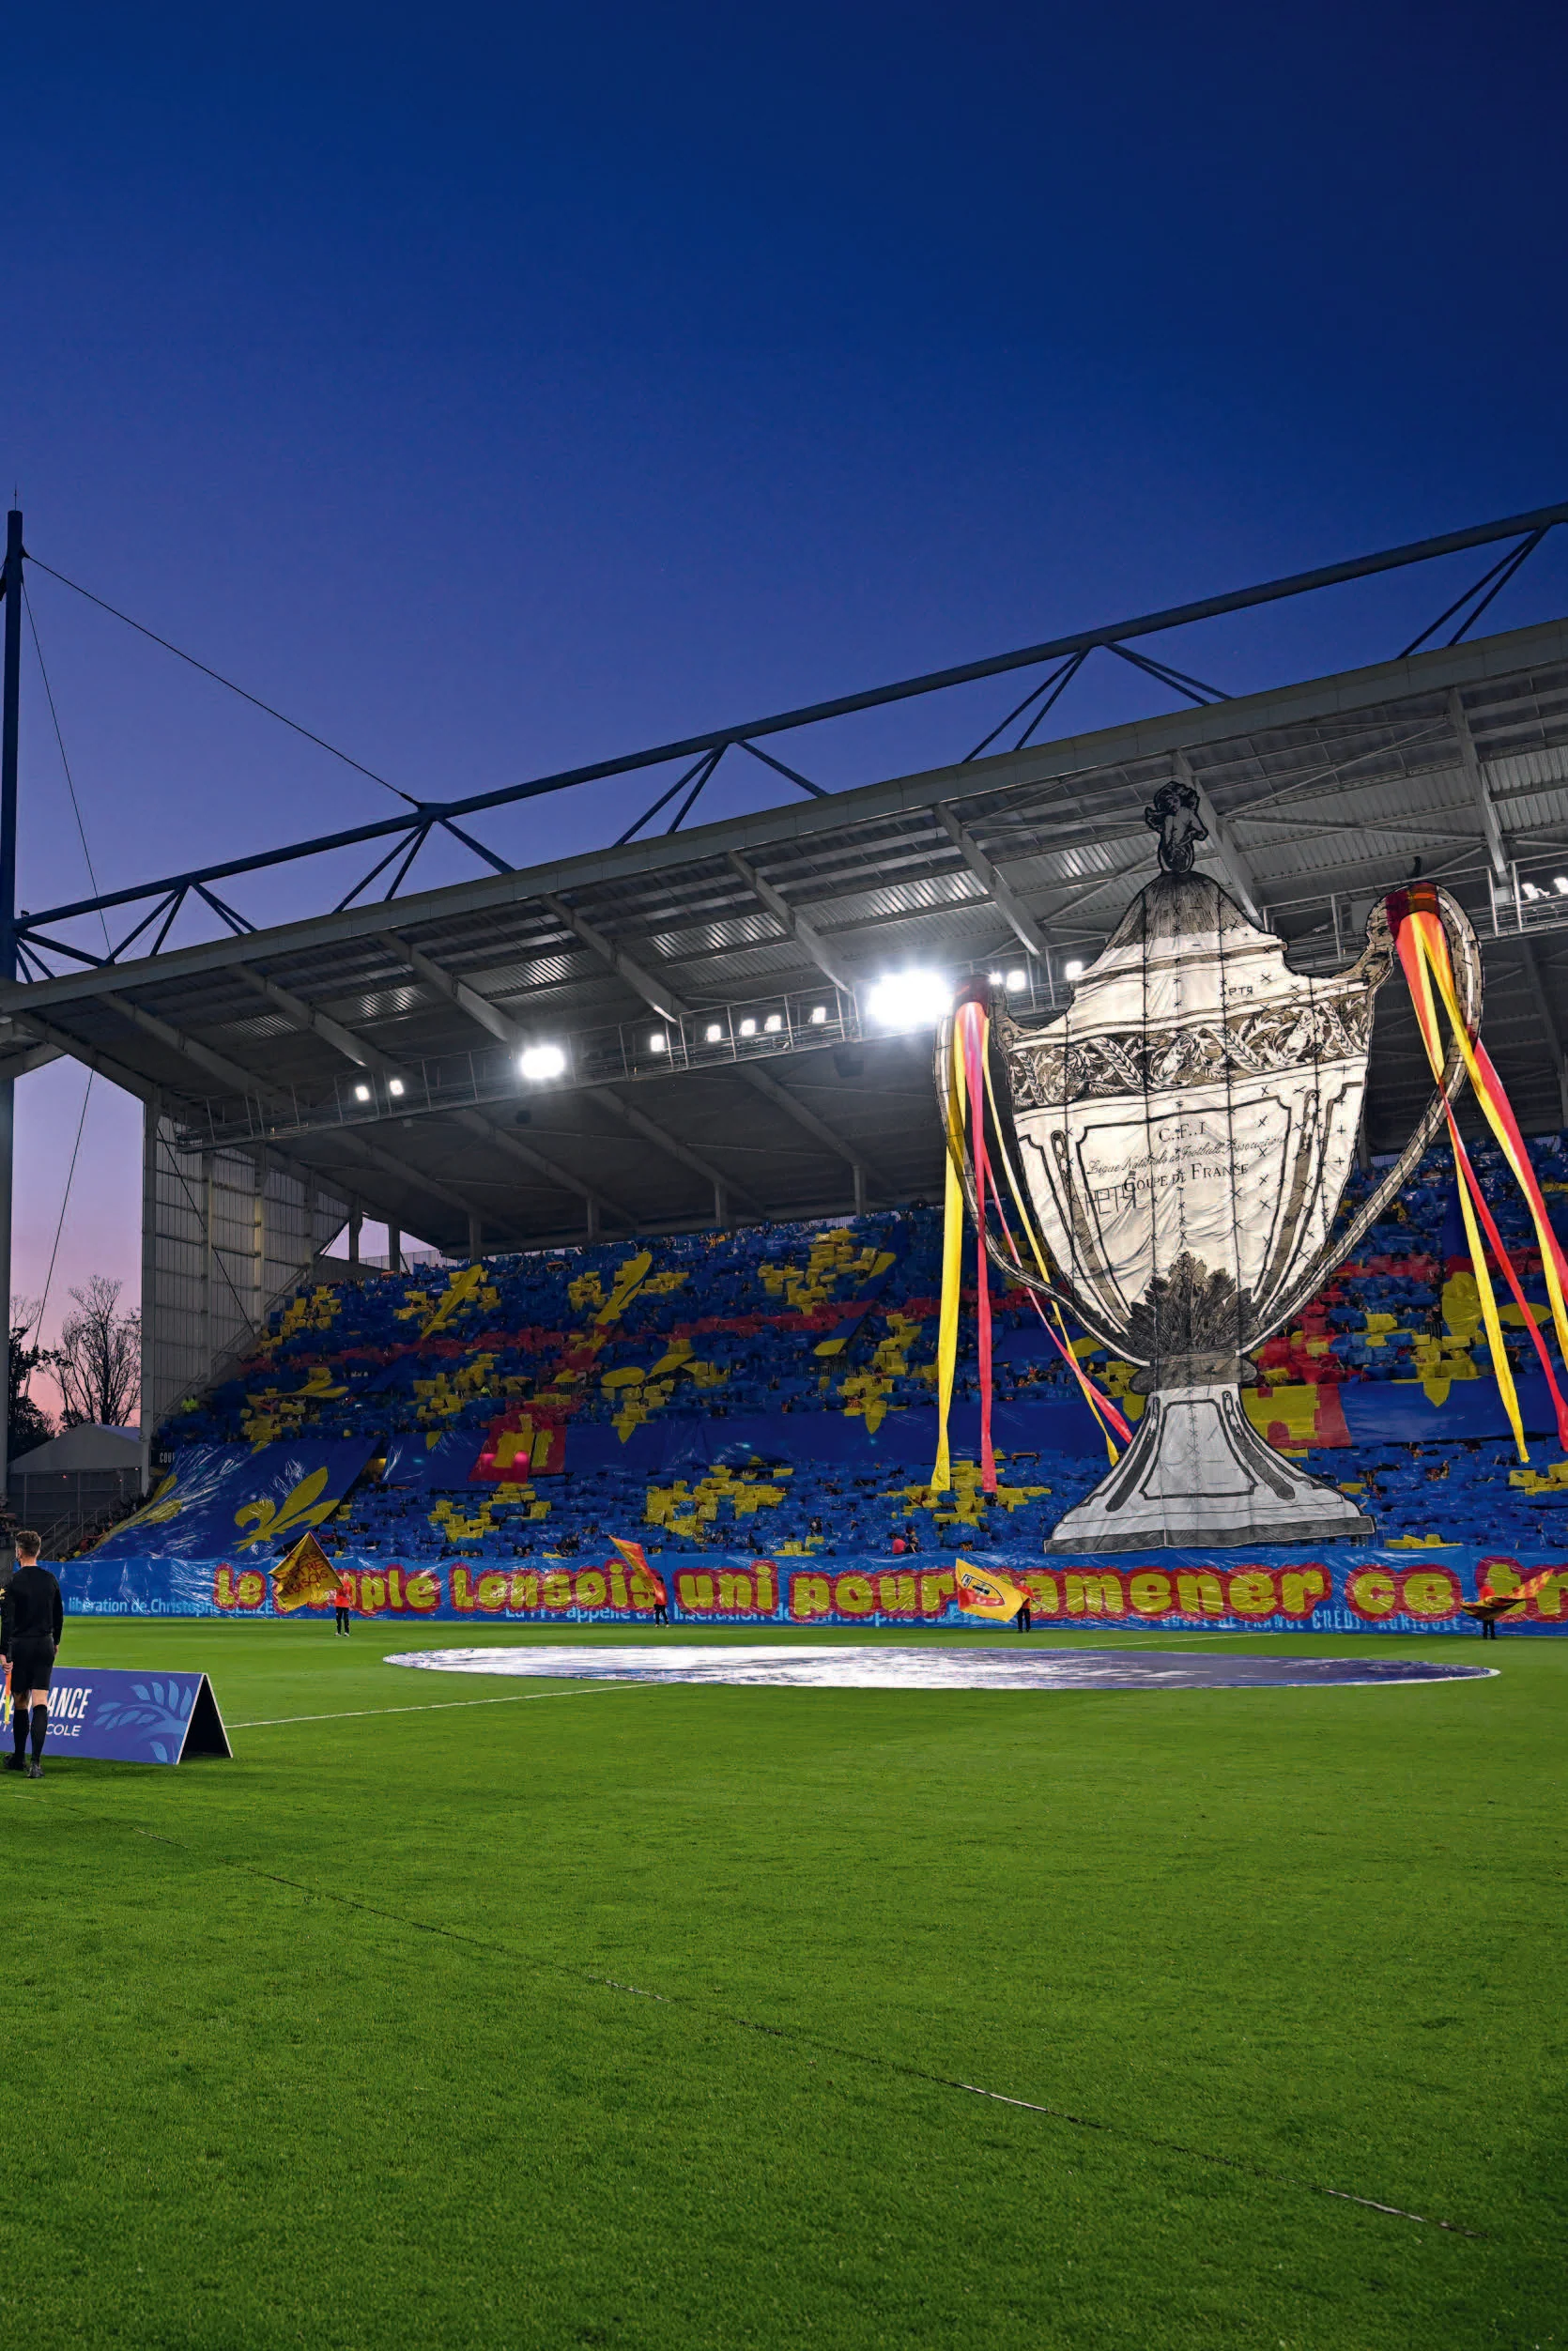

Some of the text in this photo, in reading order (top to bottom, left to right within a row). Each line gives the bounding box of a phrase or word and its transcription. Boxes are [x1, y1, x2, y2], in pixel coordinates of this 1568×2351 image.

[1191, 1162, 1249, 1180] FRANCE
[214, 1563, 266, 1610] Le
[673, 1560, 778, 1617] uni
[790, 1567, 957, 1621] pour
[997, 1564, 1330, 1621] amener
[1345, 1565, 1462, 1621] ce
[1312, 1606, 1368, 1629] CRÉDI
[28, 1687, 92, 1719] ANCE
